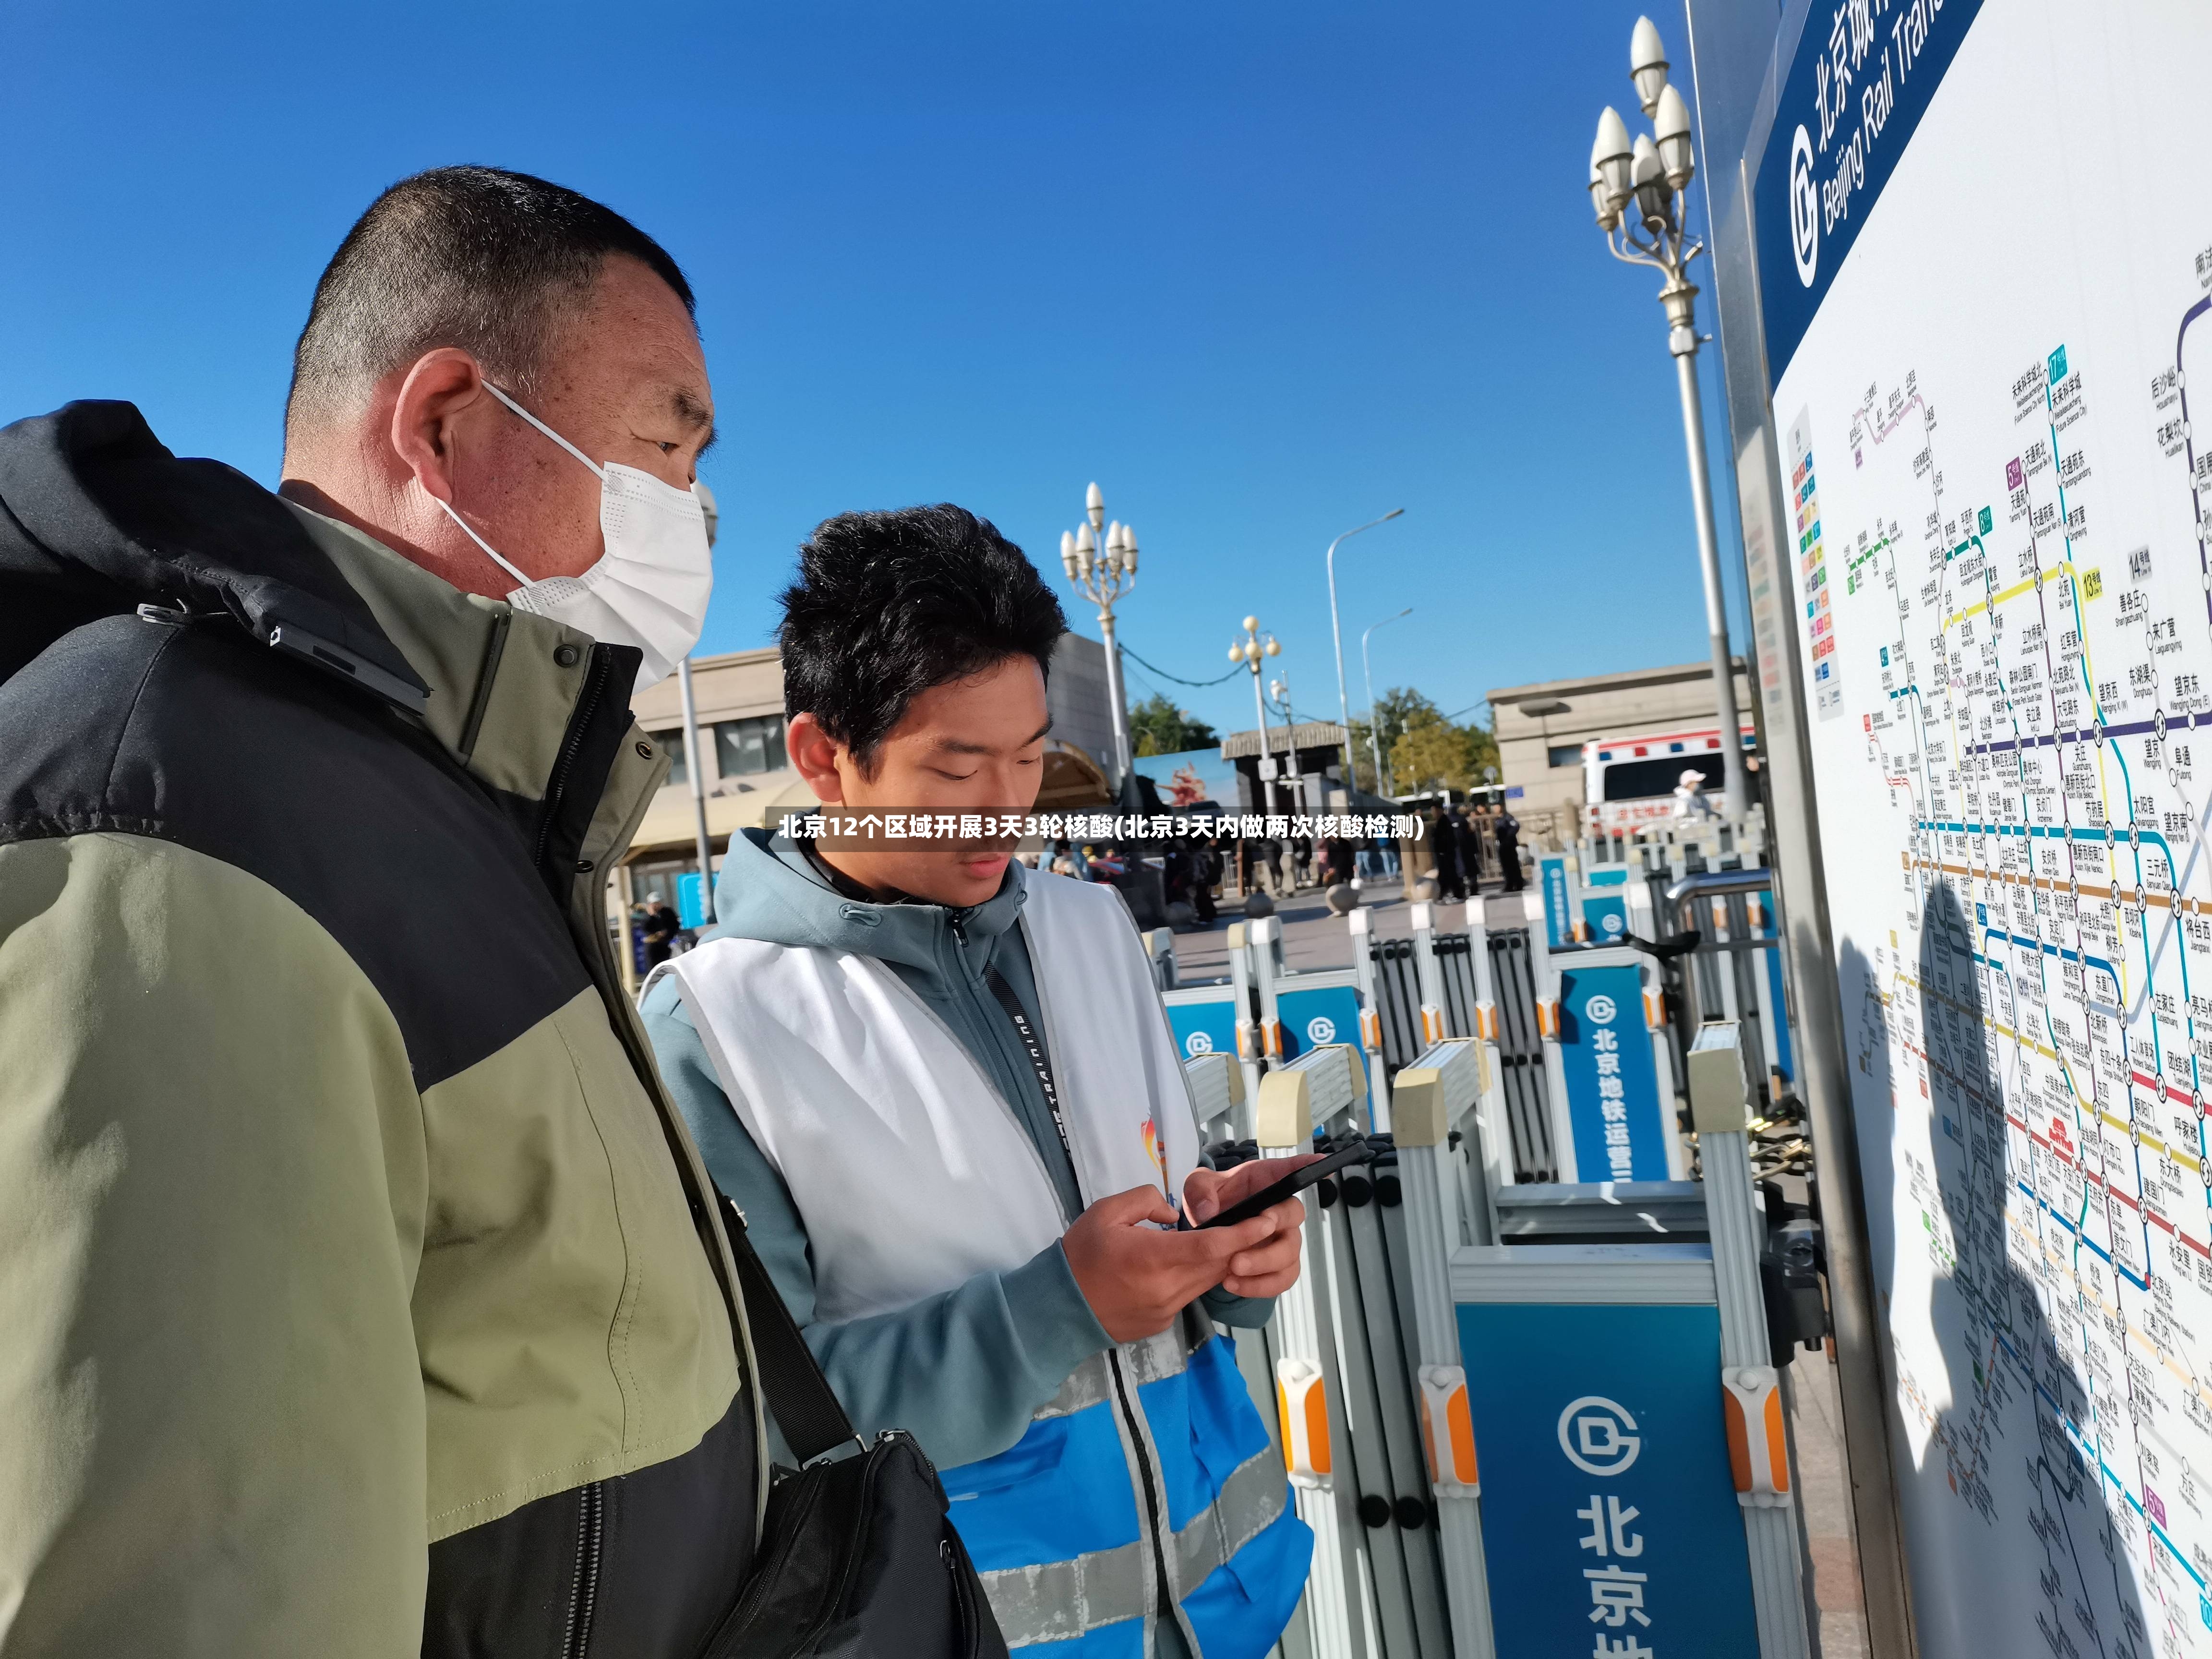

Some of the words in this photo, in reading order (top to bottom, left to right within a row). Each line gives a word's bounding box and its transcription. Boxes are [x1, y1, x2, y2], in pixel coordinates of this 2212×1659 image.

[1815, 0, 1889, 155] 北京城
[1823, 126, 1863, 236] Beijing
[1862, 46, 1893, 154] Rail
[2052, 370, 2082, 409] 未来科学城
[2152, 365, 2176, 400] 后沙峪
[2157, 416, 2183, 448] 花梨坎
[2025, 438, 2046, 468] 天通苑北
[2061, 449, 2085, 479] 天通苑东
[2011, 488, 2026, 511] 天通苑
[2033, 503, 2055, 529] 天通苑南
[2068, 503, 2086, 531] 清河营
[2018, 545, 2032, 568] 立水桥
[2058, 578, 2070, 598] 北苑
[2119, 588, 2141, 613] 善各庄
[2152, 616, 2176, 640] 来广营
[2129, 663, 2151, 686] 东湖渠
[2174, 672, 2200, 697] 望京东
[2099, 681, 2118, 702] 望京西
[2057, 697, 2080, 717] 大屯路东
[2075, 744, 2086, 762] 关庄
[2145, 737, 2160, 758] 望京
[2175, 745, 2191, 767] 阜通
[2134, 795, 2155, 815] 太阳宫
[2164, 812, 2188, 835] 望京南
[2147, 858, 2168, 878] 三元桥
[2095, 973, 2114, 995] 东直门
[2155, 990, 2176, 1013] 左家庄
[1014, 1015, 1057, 1105] TRAINING
[2167, 1050, 2191, 1078] 团结湖
[2174, 1116, 2199, 1144] 呼家楼
[2159, 1156, 2181, 1185] 东大桥
[2143, 1176, 2165, 1205] 建国门
[2169, 1238, 2191, 1270] 永安里
[2152, 1269, 2173, 1302] 北京站
